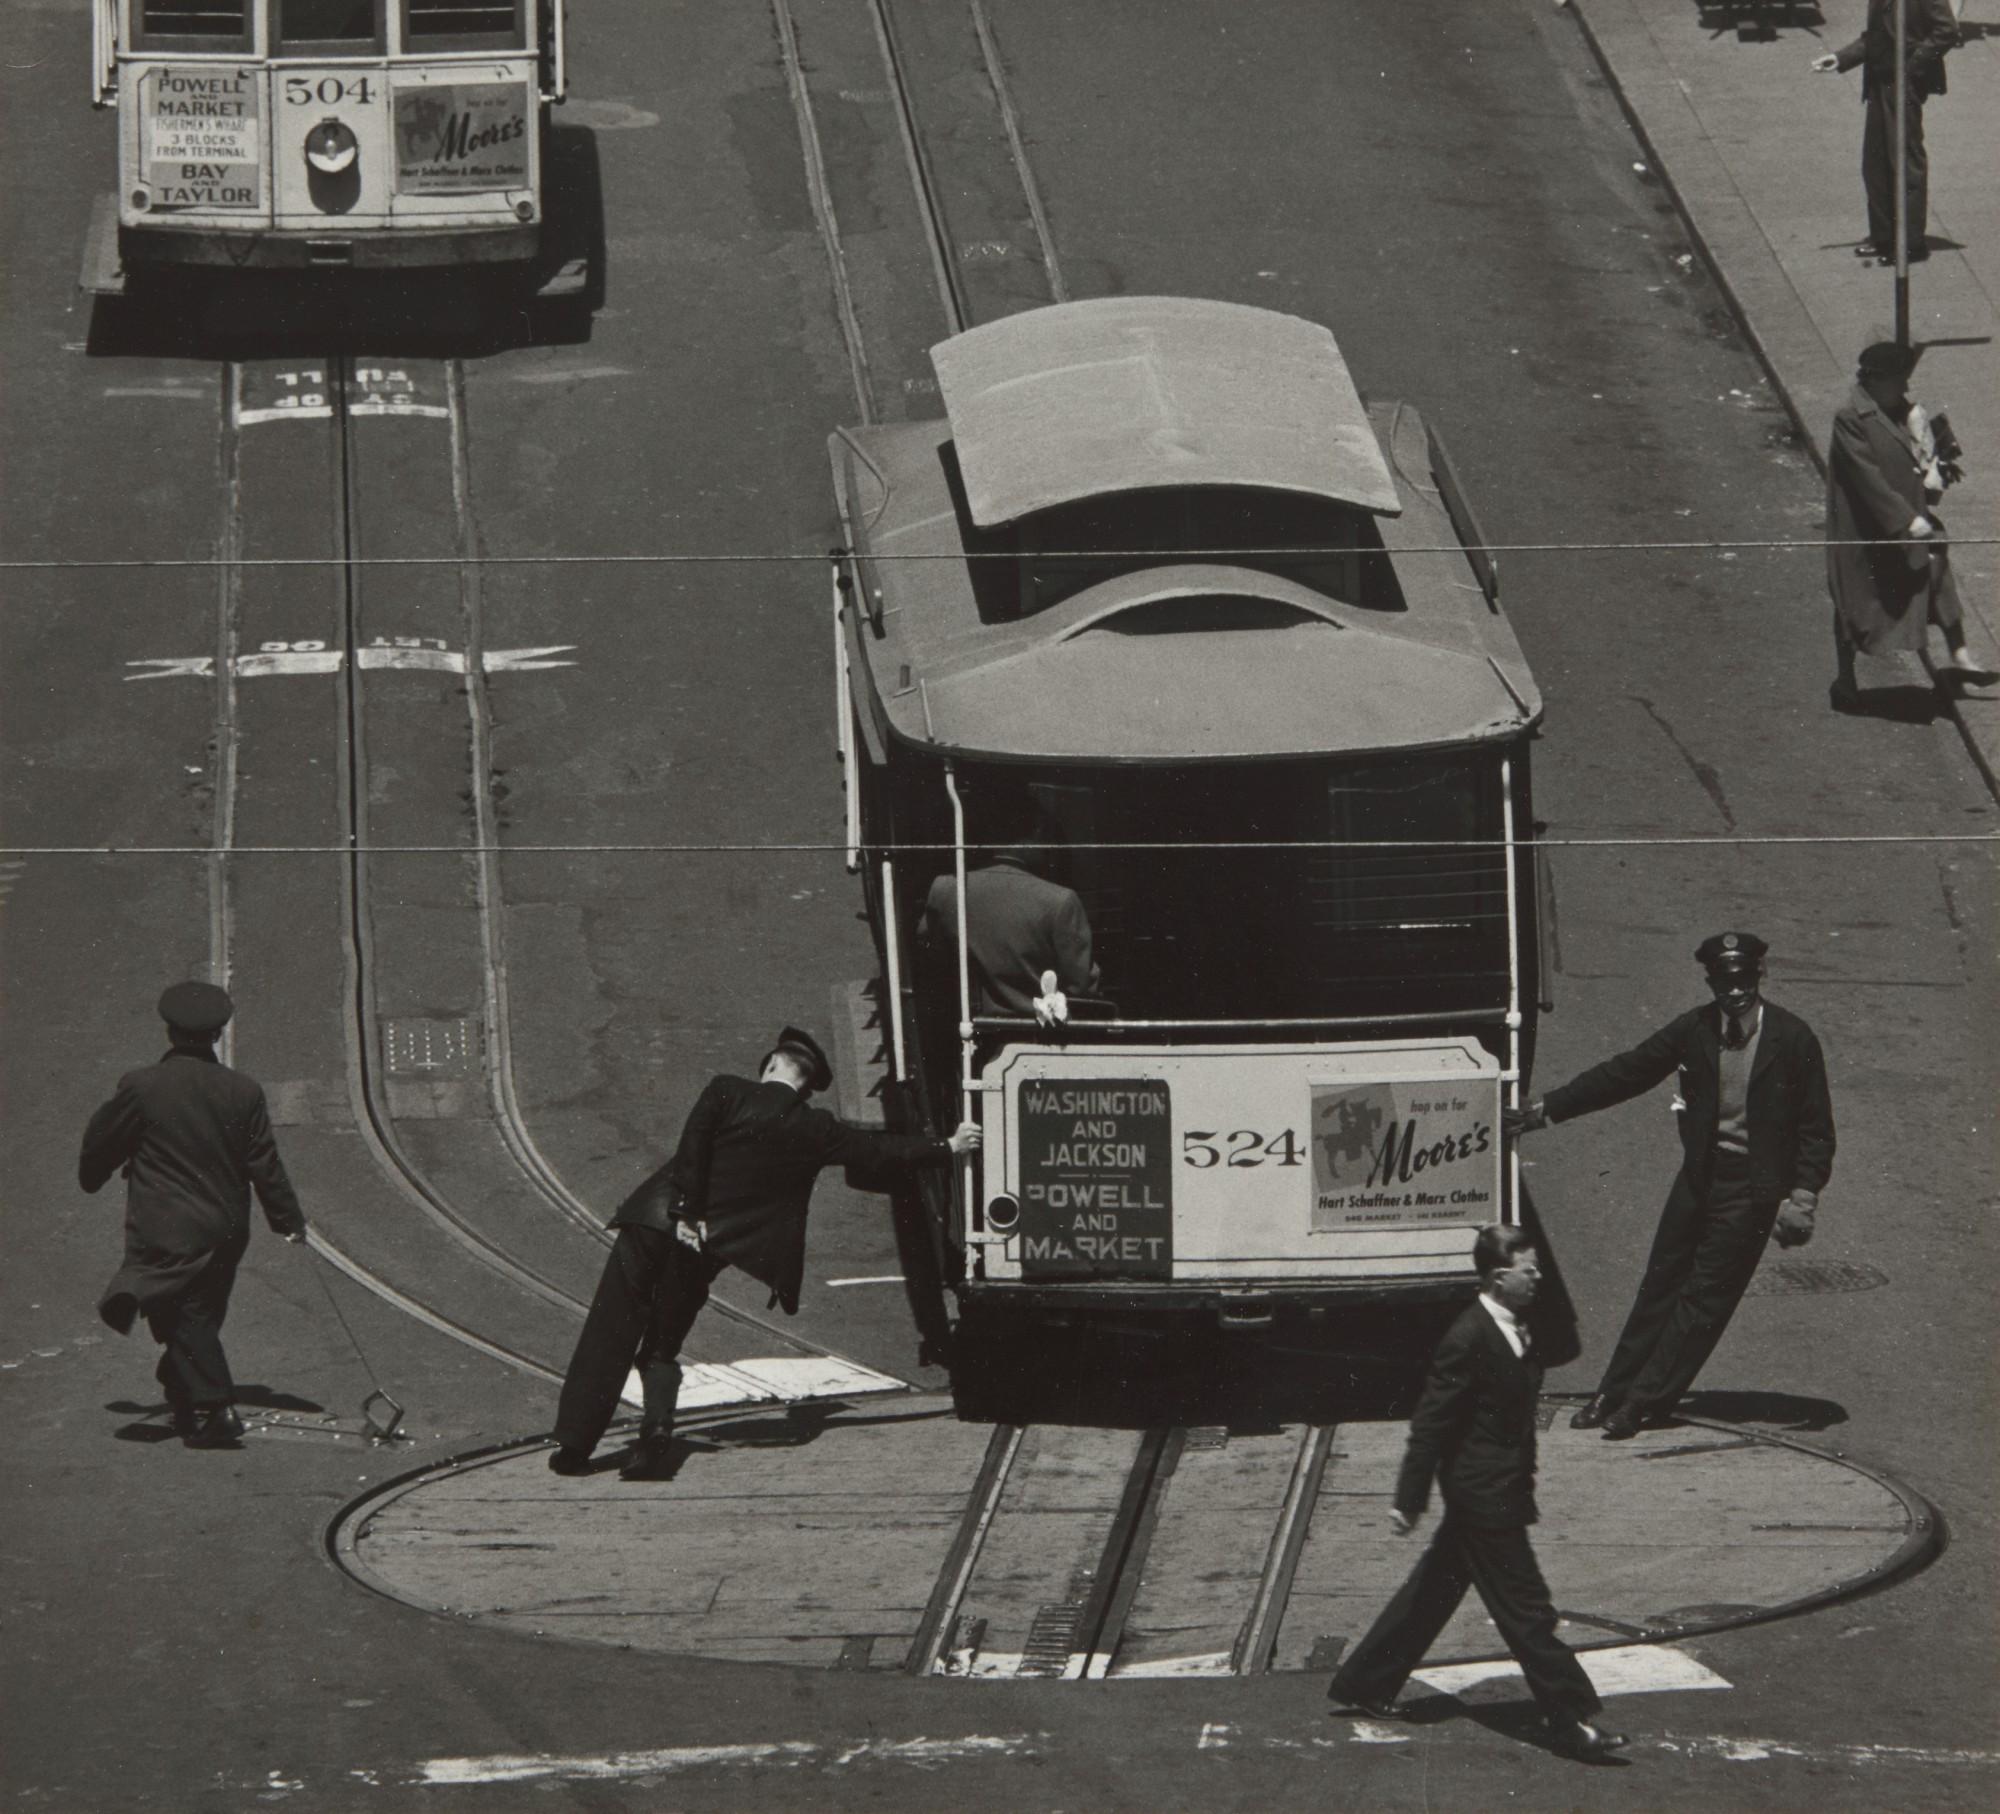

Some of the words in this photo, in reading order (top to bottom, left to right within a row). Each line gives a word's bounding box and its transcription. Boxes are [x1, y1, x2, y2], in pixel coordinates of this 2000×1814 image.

[158, 78, 246, 94] POWELL
[285, 77, 378, 107] 504
[158, 101, 245, 117] MARKET
[171, 134, 180, 146] 3
[185, 134, 237, 146] BLOCKS
[433, 111, 525, 163] Moore's
[156, 146, 187, 157] FROM
[190, 146, 247, 158] TERMINAL
[181, 164, 229, 179] BAY
[159, 187, 253, 203] TAYLOR
[1024, 1091, 1166, 1116] WASHINGTON
[1409, 1100, 1429, 1115] hop
[1434, 1101, 1448, 1112] on
[1451, 1098, 1468, 1112] for
[1071, 1120, 1117, 1138] AND
[1040, 1143, 1147, 1168] JACKSON
[1183, 1127, 1306, 1169] 524
[1365, 1118, 1491, 1188] Moore's
[1025, 1184, 1165, 1209] POWELL
[1318, 1196, 1345, 1210] Hart
[1348, 1191, 1401, 1209] Schaffner
[1402, 1193, 1413, 1207] &
[1415, 1191, 1447, 1206] Marx
[1450, 1188, 1490, 1203] Clothes
[1071, 1213, 1118, 1232] AND
[1365, 1213, 1402, 1222] MARKET
[1024, 1236, 1165, 1261] MARKET
